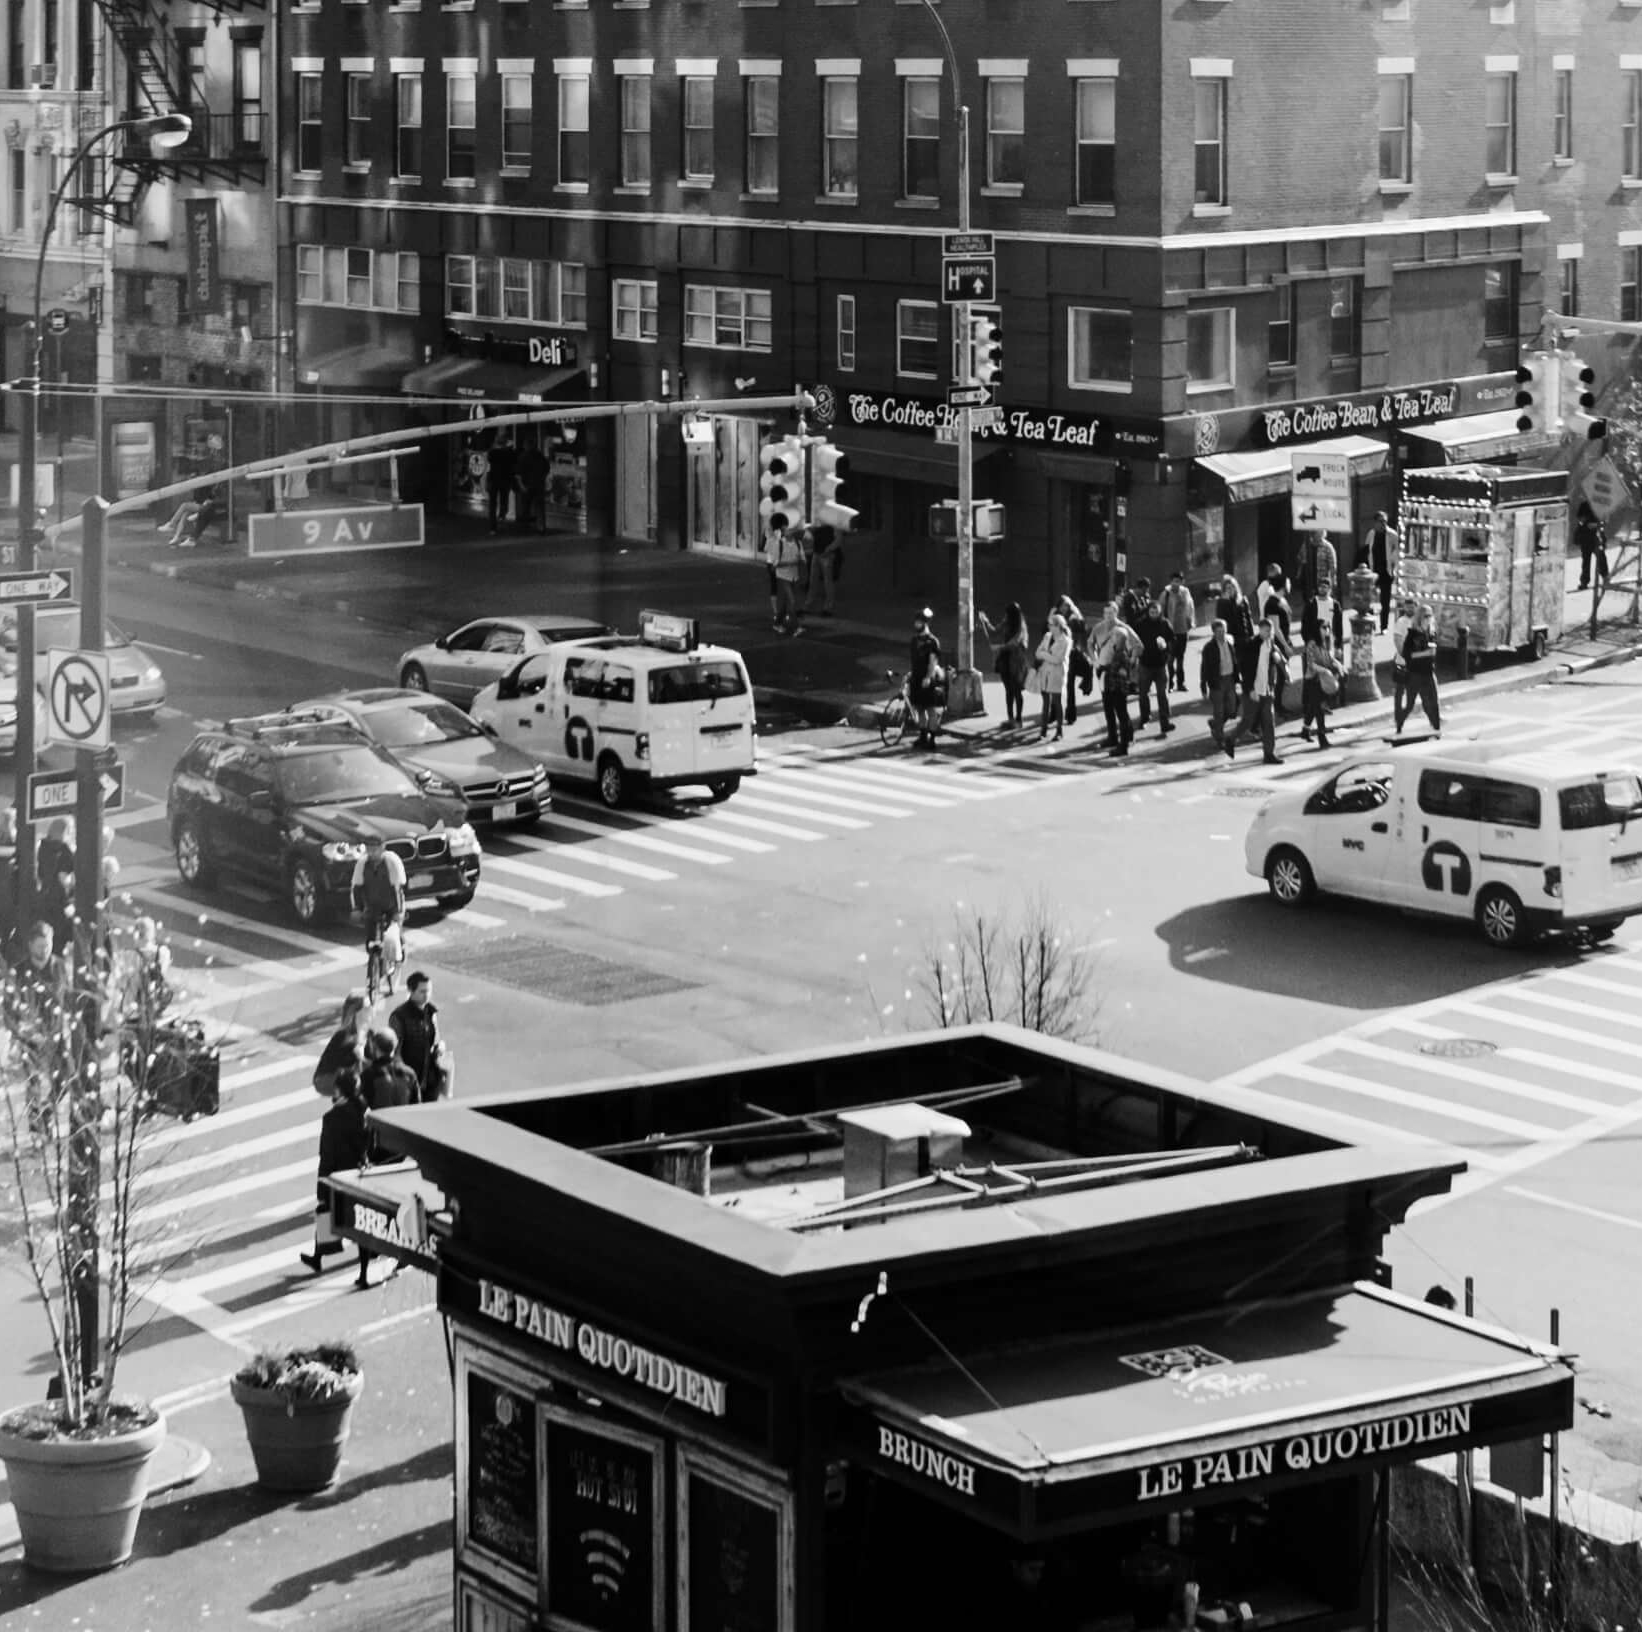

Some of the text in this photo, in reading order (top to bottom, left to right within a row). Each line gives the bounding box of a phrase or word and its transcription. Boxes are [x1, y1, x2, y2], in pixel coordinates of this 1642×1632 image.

[529, 337, 562, 365] Deli
[848, 394, 879, 424] The
[882, 398, 935, 427] Coffee
[1010, 411, 1046, 440] Tea
[1047, 415, 1100, 446] Leaf
[1265, 386, 1457, 442] The Coffee Bean & Tea Leaf
[302, 517, 374, 545] 9 Av
[1, 546, 16, 564] ST
[6, 579, 62, 595] ONE WAY
[42, 784, 70, 805] ONE
[478, 1279, 726, 1417] LE PAIN QUOTIDIEN
[878, 1426, 975, 1496] BRUNCH
[1137, 1403, 1473, 1501] LE PAIN QUOTIDIEN
